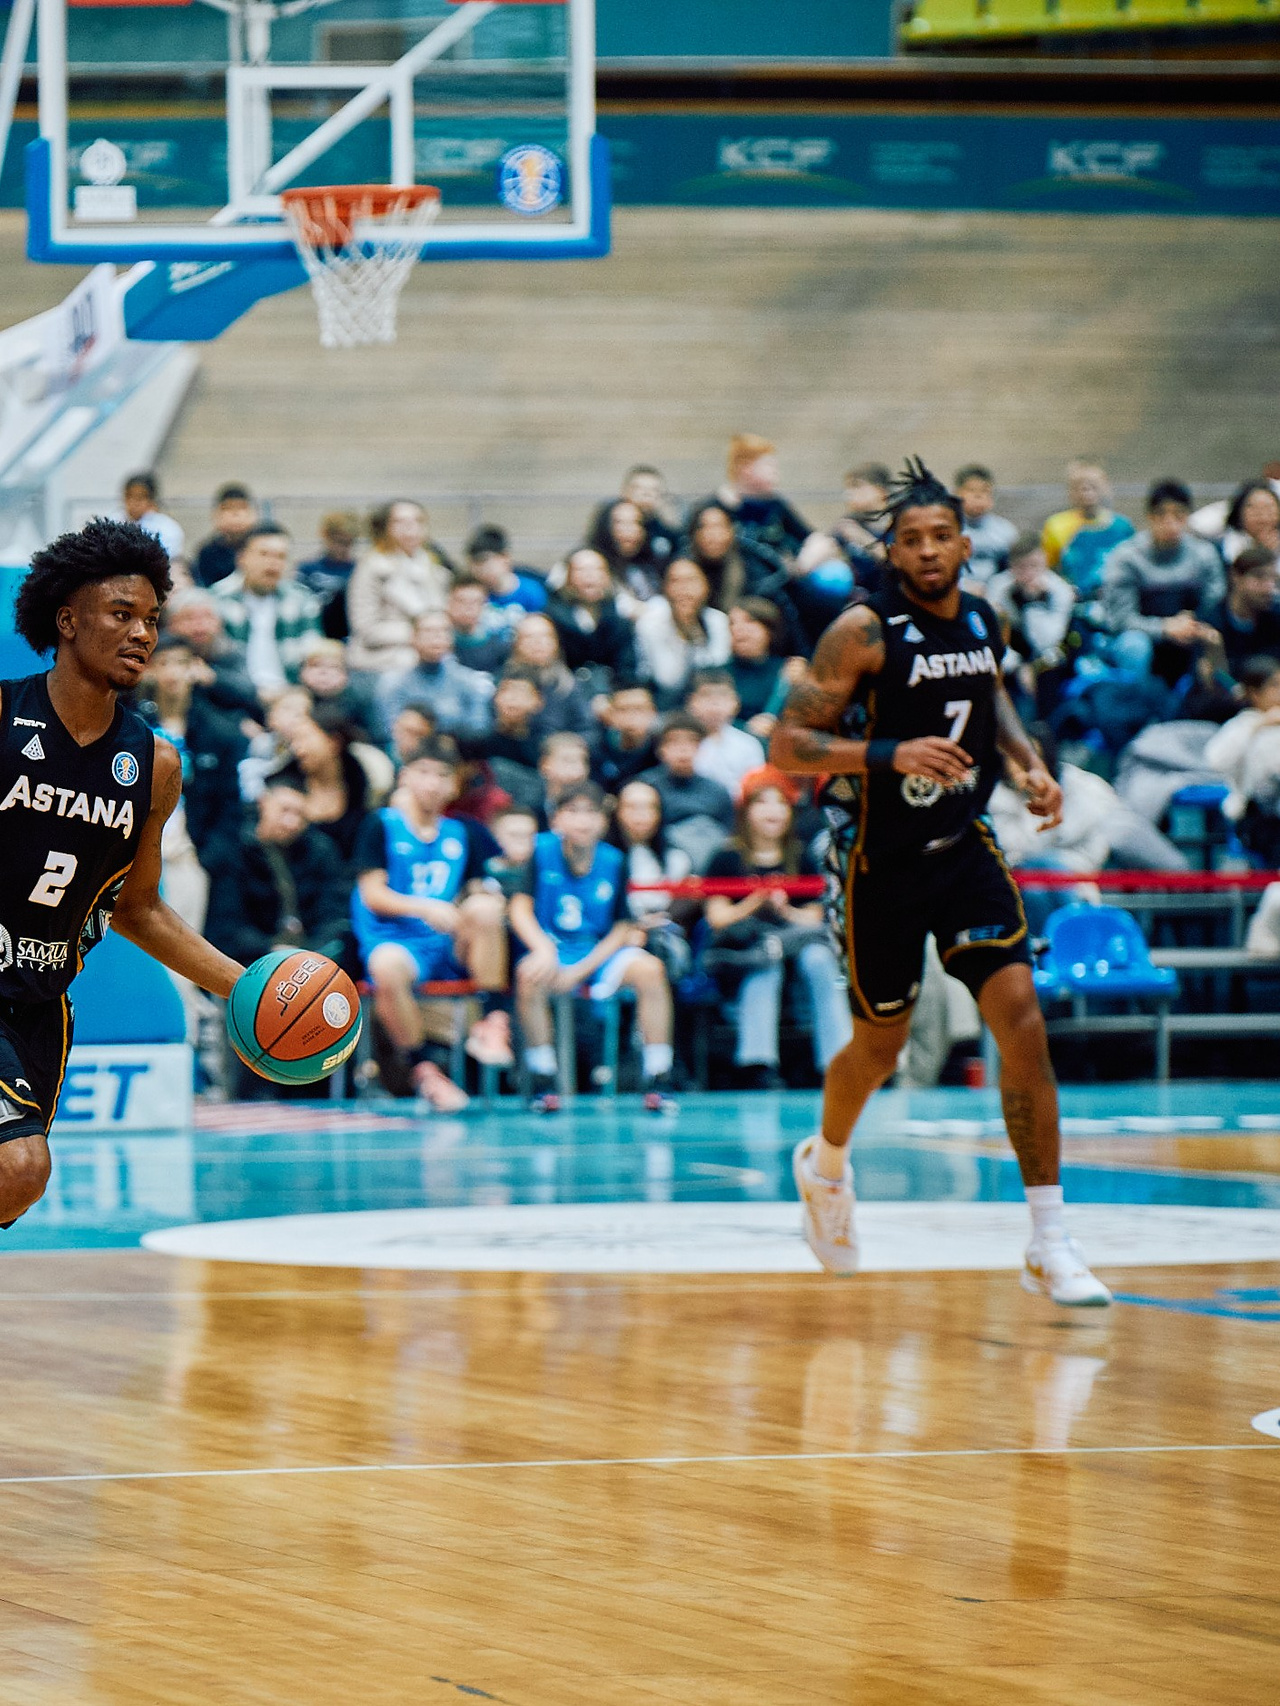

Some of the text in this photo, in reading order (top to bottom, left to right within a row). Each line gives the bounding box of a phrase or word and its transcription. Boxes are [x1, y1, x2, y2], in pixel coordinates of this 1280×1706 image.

[907, 646, 998, 687] ASTANA
[944, 699, 972, 743] 7
[28, 850, 78, 908] 2
